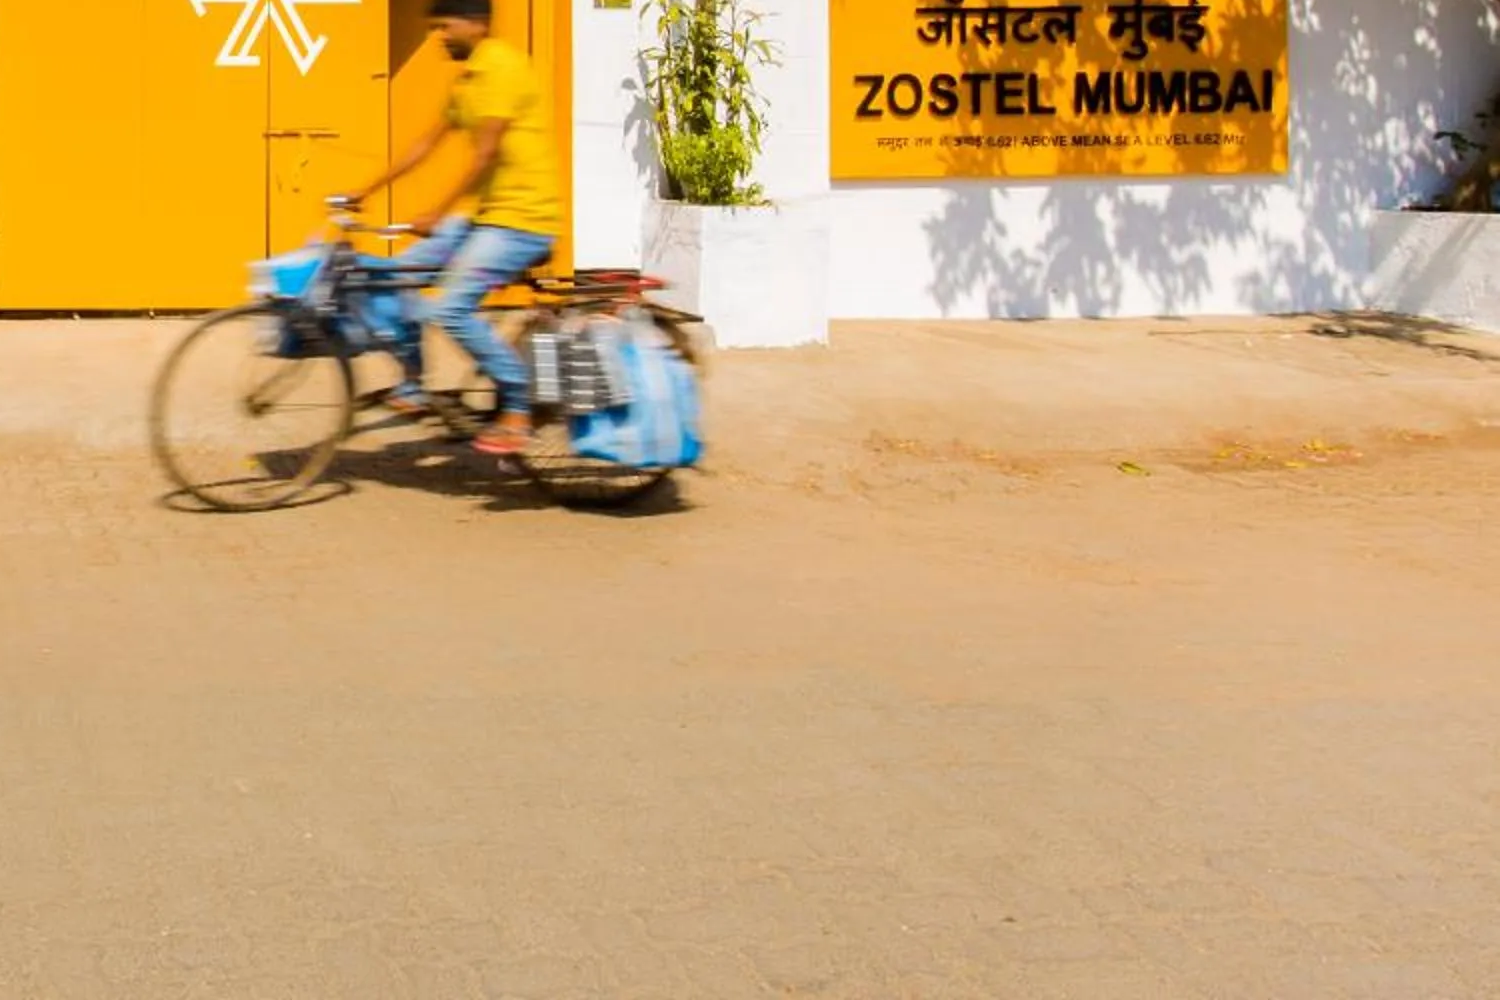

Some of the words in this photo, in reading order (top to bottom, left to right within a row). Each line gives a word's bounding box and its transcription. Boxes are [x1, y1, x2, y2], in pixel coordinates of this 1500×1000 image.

[854, 72, 1057, 119] ZOSTEL
[1073, 68, 1274, 116] MUMBAI
[1021, 135, 1067, 148] ABOVE
[1071, 134, 1111, 147] MEAN
[1114, 134, 1143, 147] SEA
[1147, 133, 1189, 146] LEVEL
